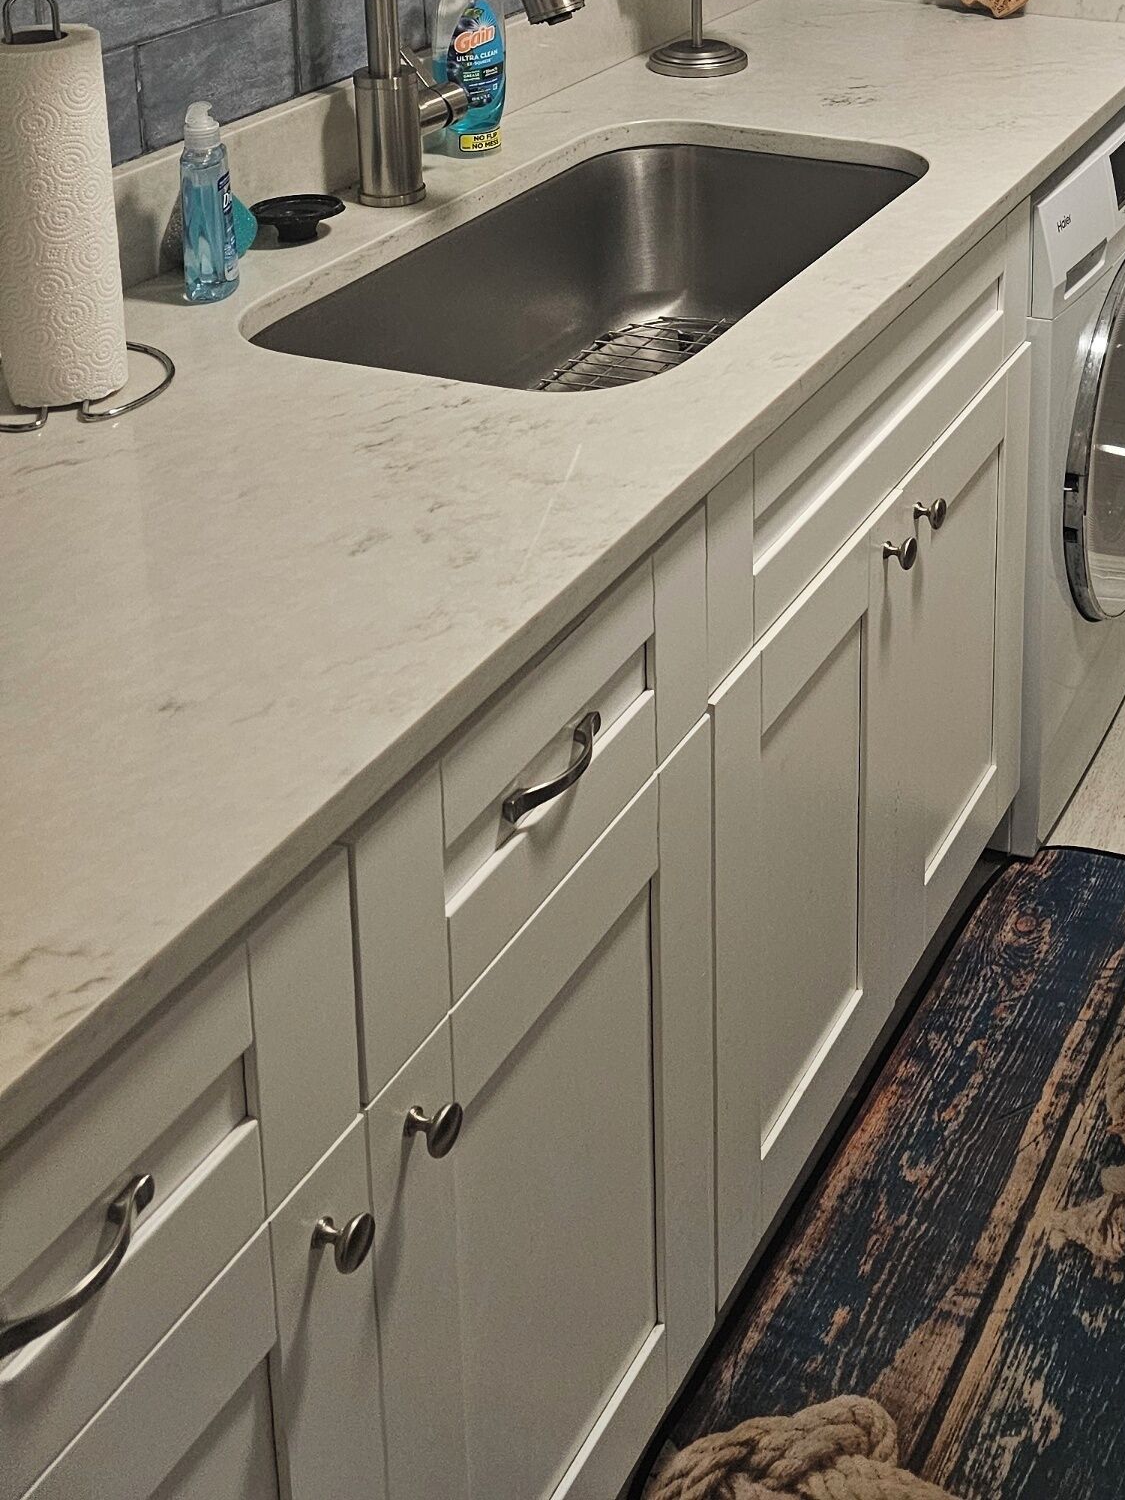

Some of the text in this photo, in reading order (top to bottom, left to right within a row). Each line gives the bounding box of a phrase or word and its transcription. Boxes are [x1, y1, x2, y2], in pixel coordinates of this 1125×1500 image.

[454, 26, 495, 54] Gain
[456, 50, 498, 62] ULTRA CLEAN
[486, 132, 498, 140] FLIP
[485, 140, 499, 148] MESS
[1056, 214, 1072, 232] Haier
